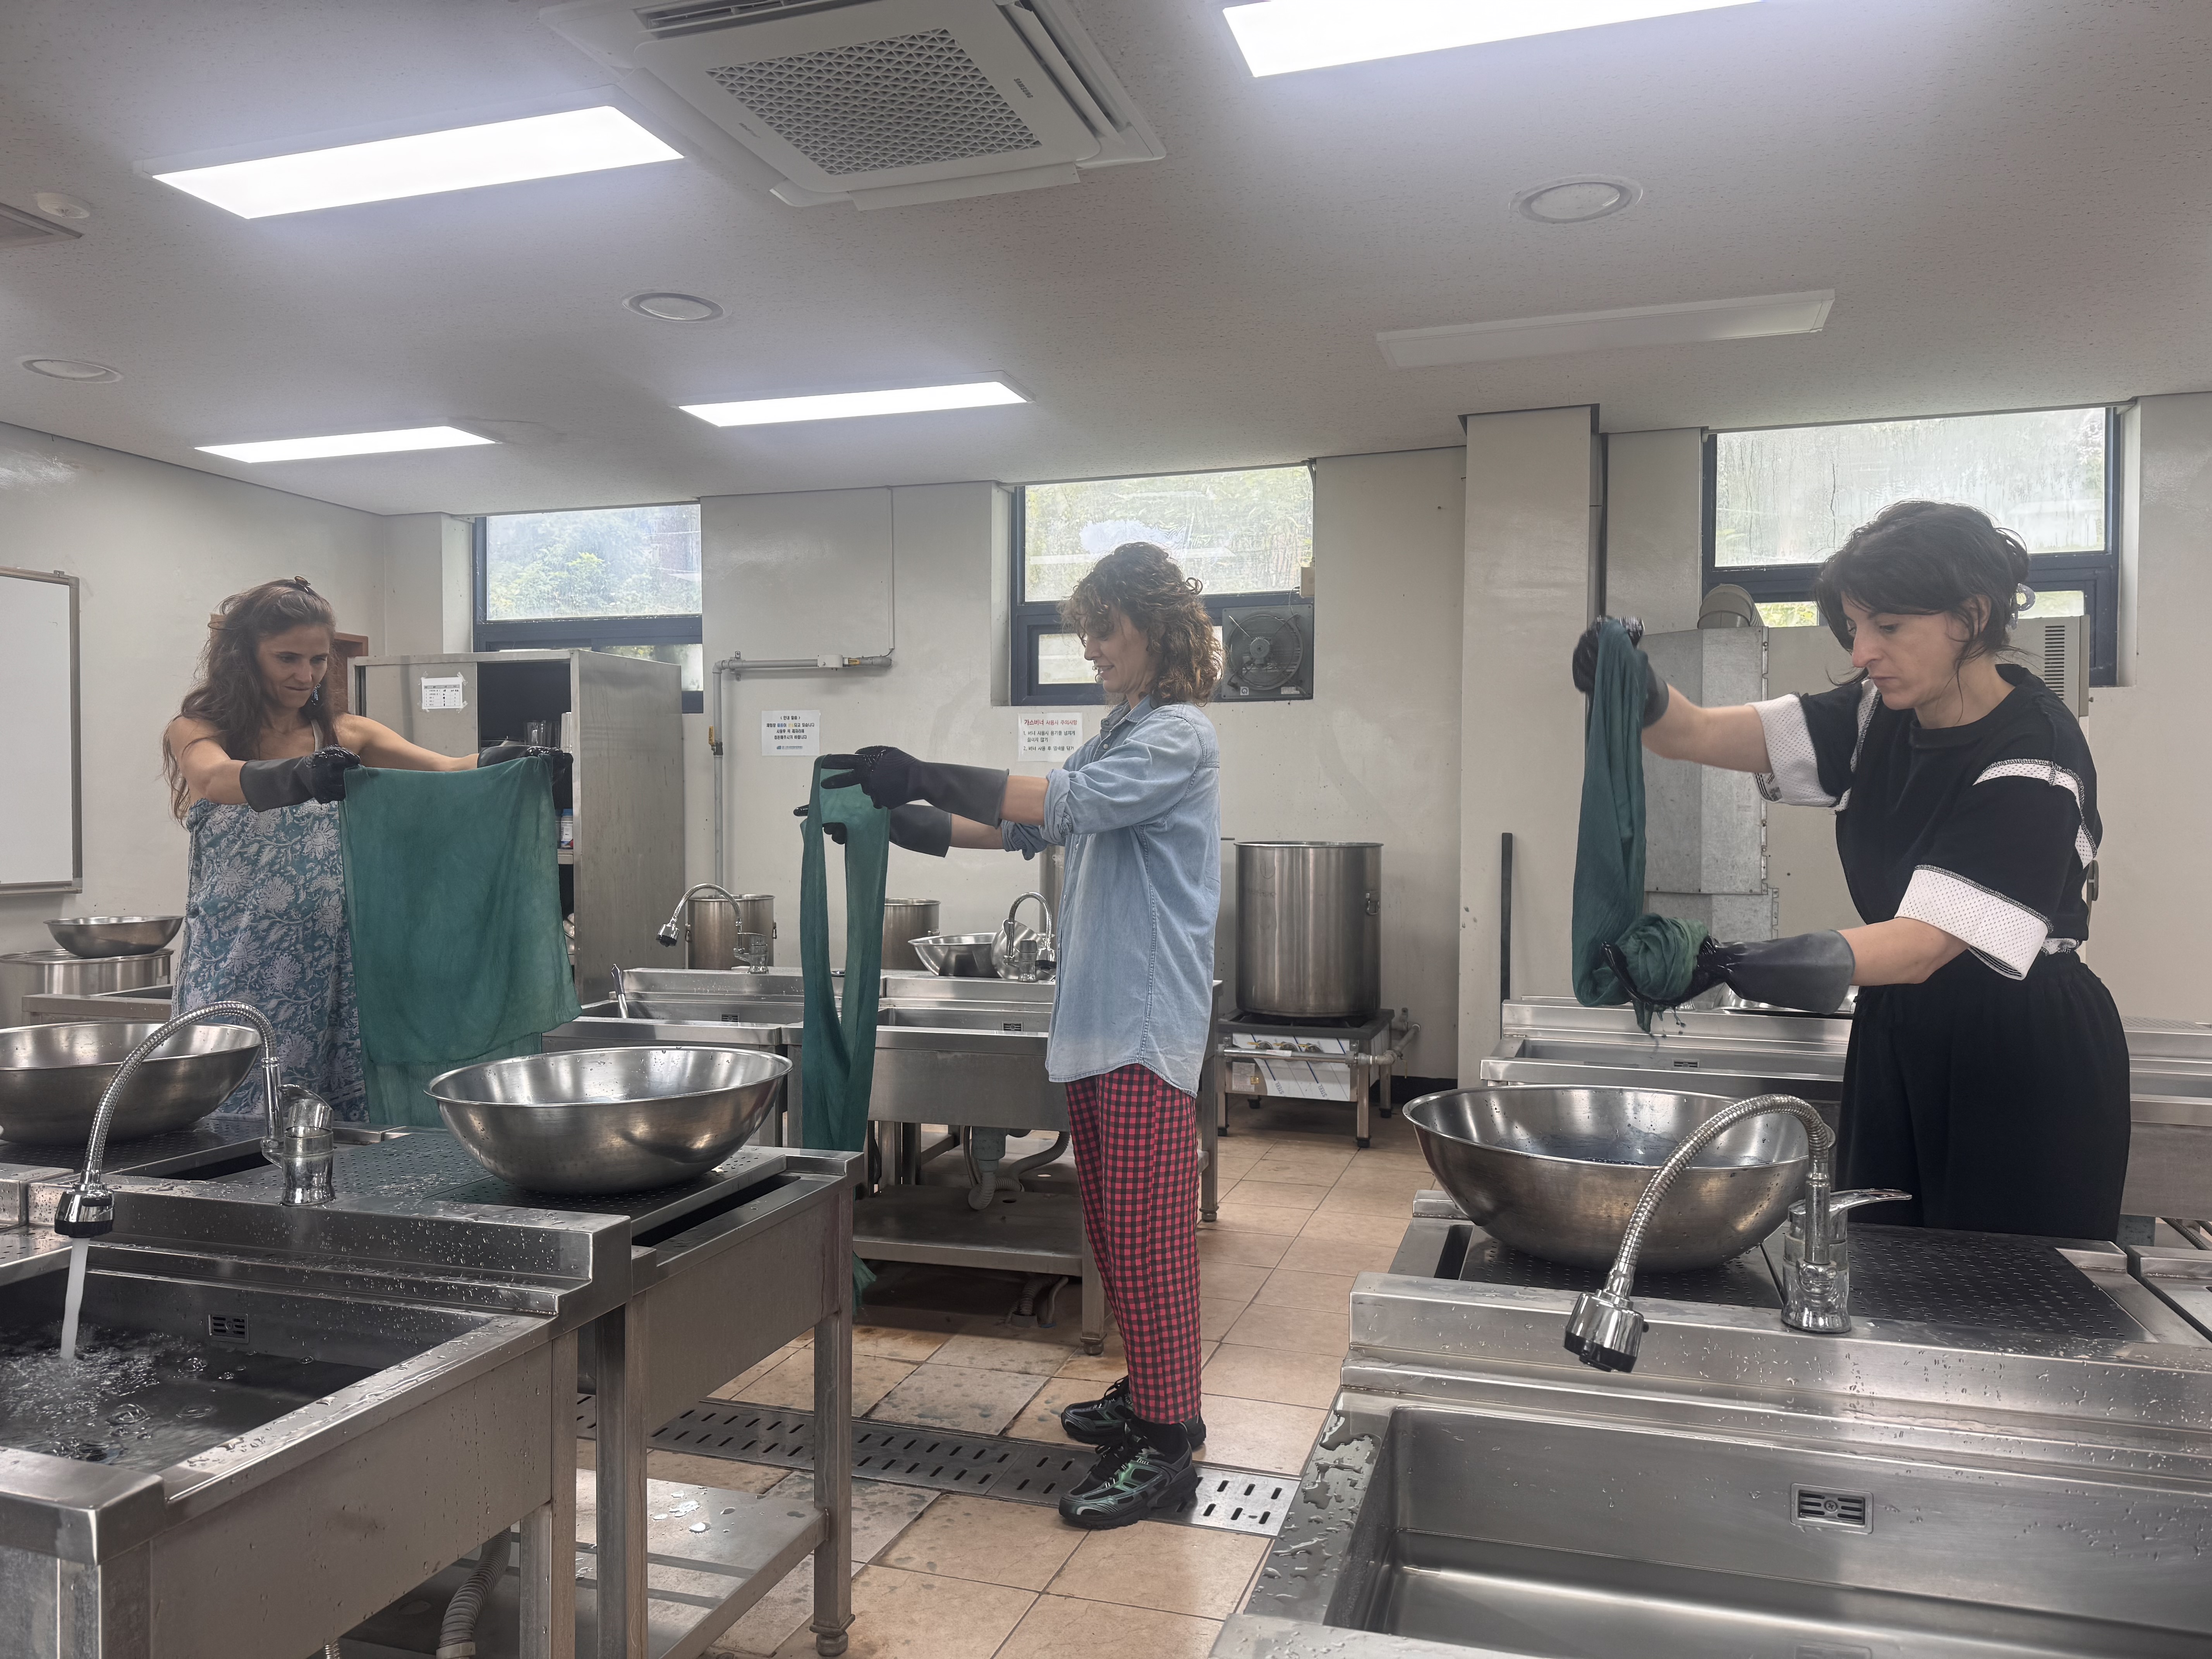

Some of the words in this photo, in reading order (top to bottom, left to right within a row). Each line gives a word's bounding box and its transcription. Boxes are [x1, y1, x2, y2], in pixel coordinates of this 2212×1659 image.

[1013, 78, 1033, 98] SAMSUNG
[1275, 1081, 1285, 1094] STEEL
[1318, 1084, 1328, 1097] STEEL
